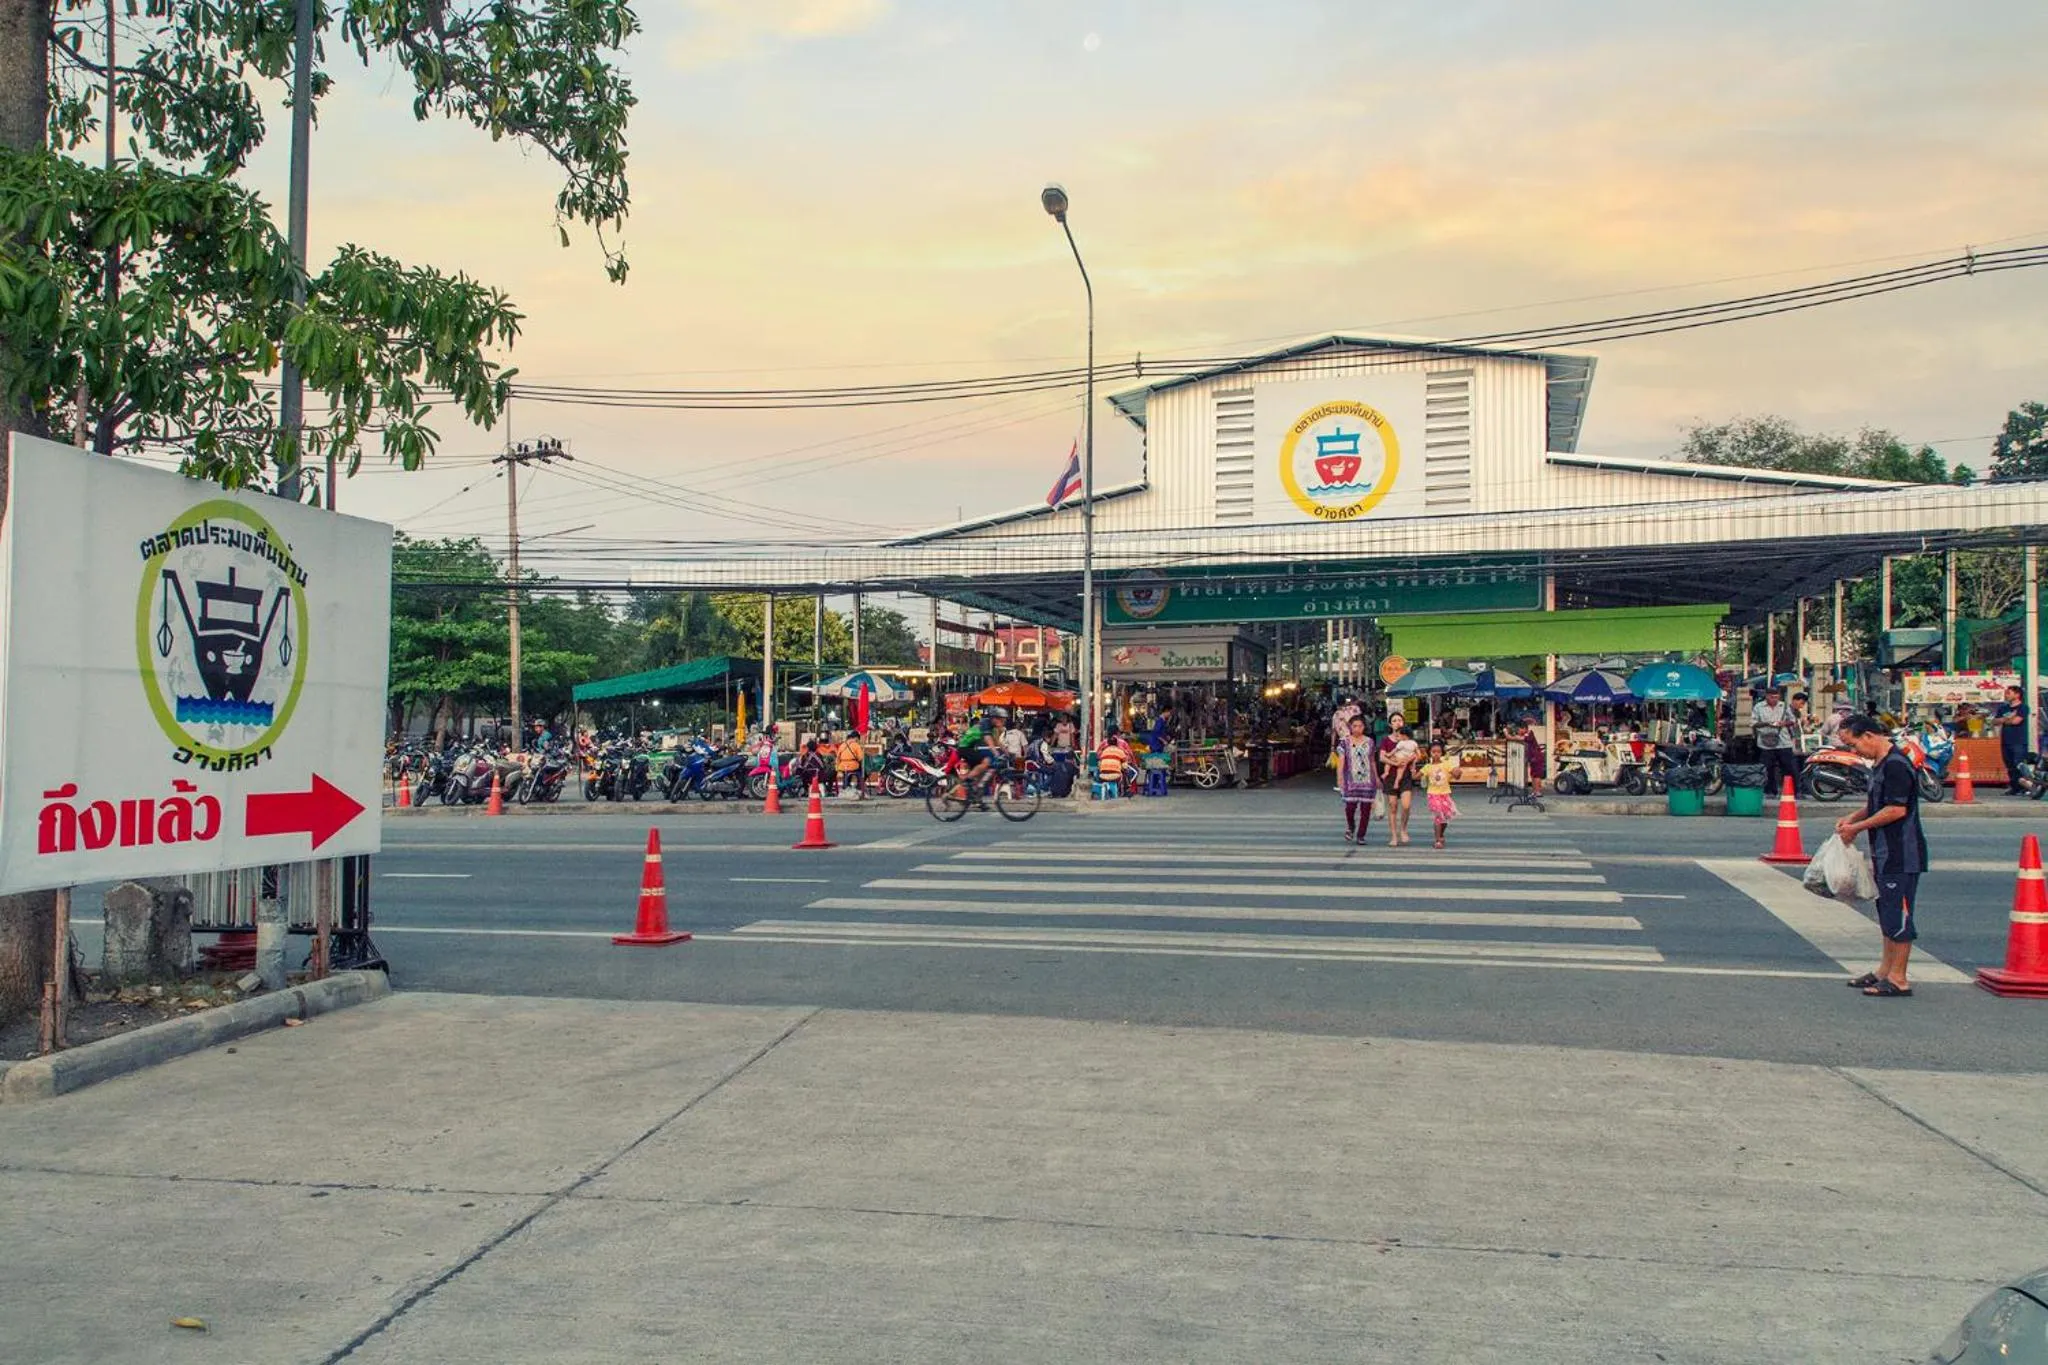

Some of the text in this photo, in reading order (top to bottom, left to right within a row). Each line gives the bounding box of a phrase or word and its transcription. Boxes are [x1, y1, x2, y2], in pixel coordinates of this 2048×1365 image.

[1314, 503, 1363, 520] อ่างศิลา
[140, 518, 309, 589] ตลาดประมงพื้นบ้าน
[172, 741, 273, 772] อ่างศิลา
[37, 779, 222, 855] ถึงแล้ว
